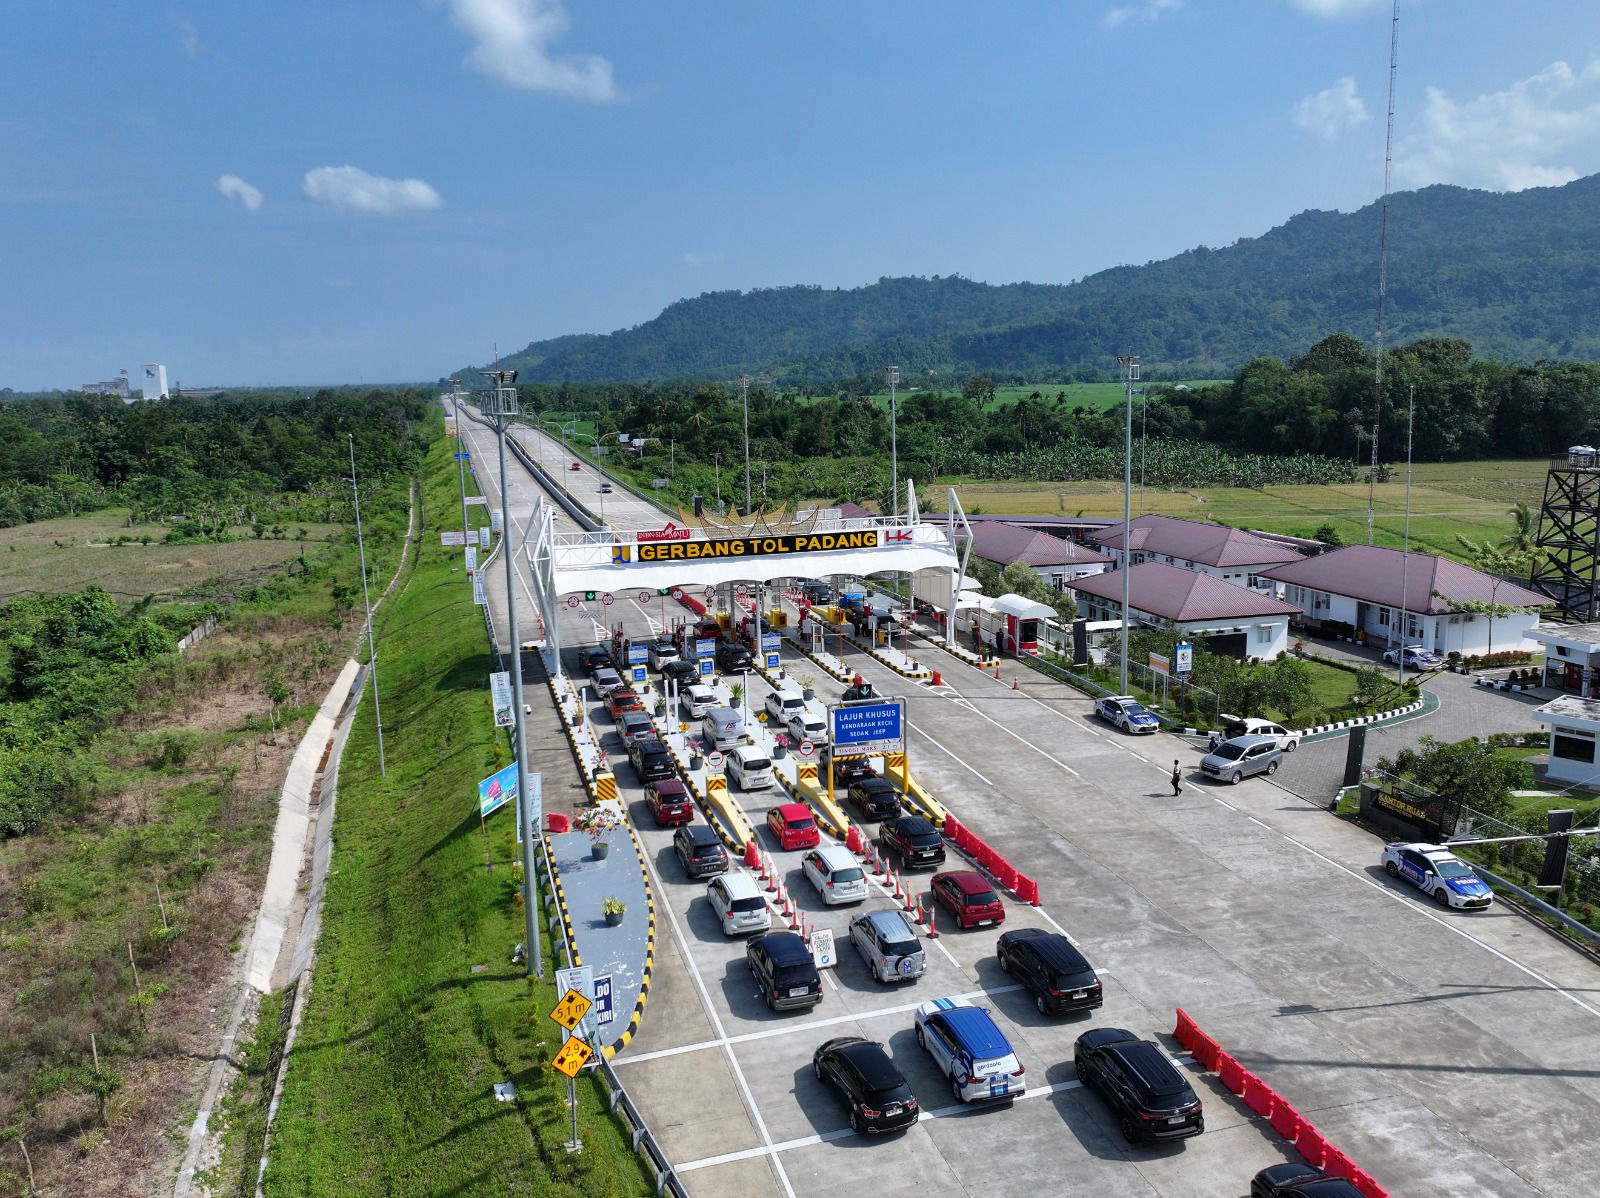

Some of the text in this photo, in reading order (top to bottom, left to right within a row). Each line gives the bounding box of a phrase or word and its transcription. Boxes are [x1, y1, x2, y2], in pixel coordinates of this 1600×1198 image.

[886, 530, 912, 542] HK
[640, 532, 877, 560] GERBANG TOL PADANG
[839, 710, 896, 721] LAJUR KHUSUS
[557, 1006, 571, 1019] 5,1
[575, 1002, 585, 1013] m
[565, 1043, 580, 1057] 2,9
[568, 1059, 578, 1070] m
